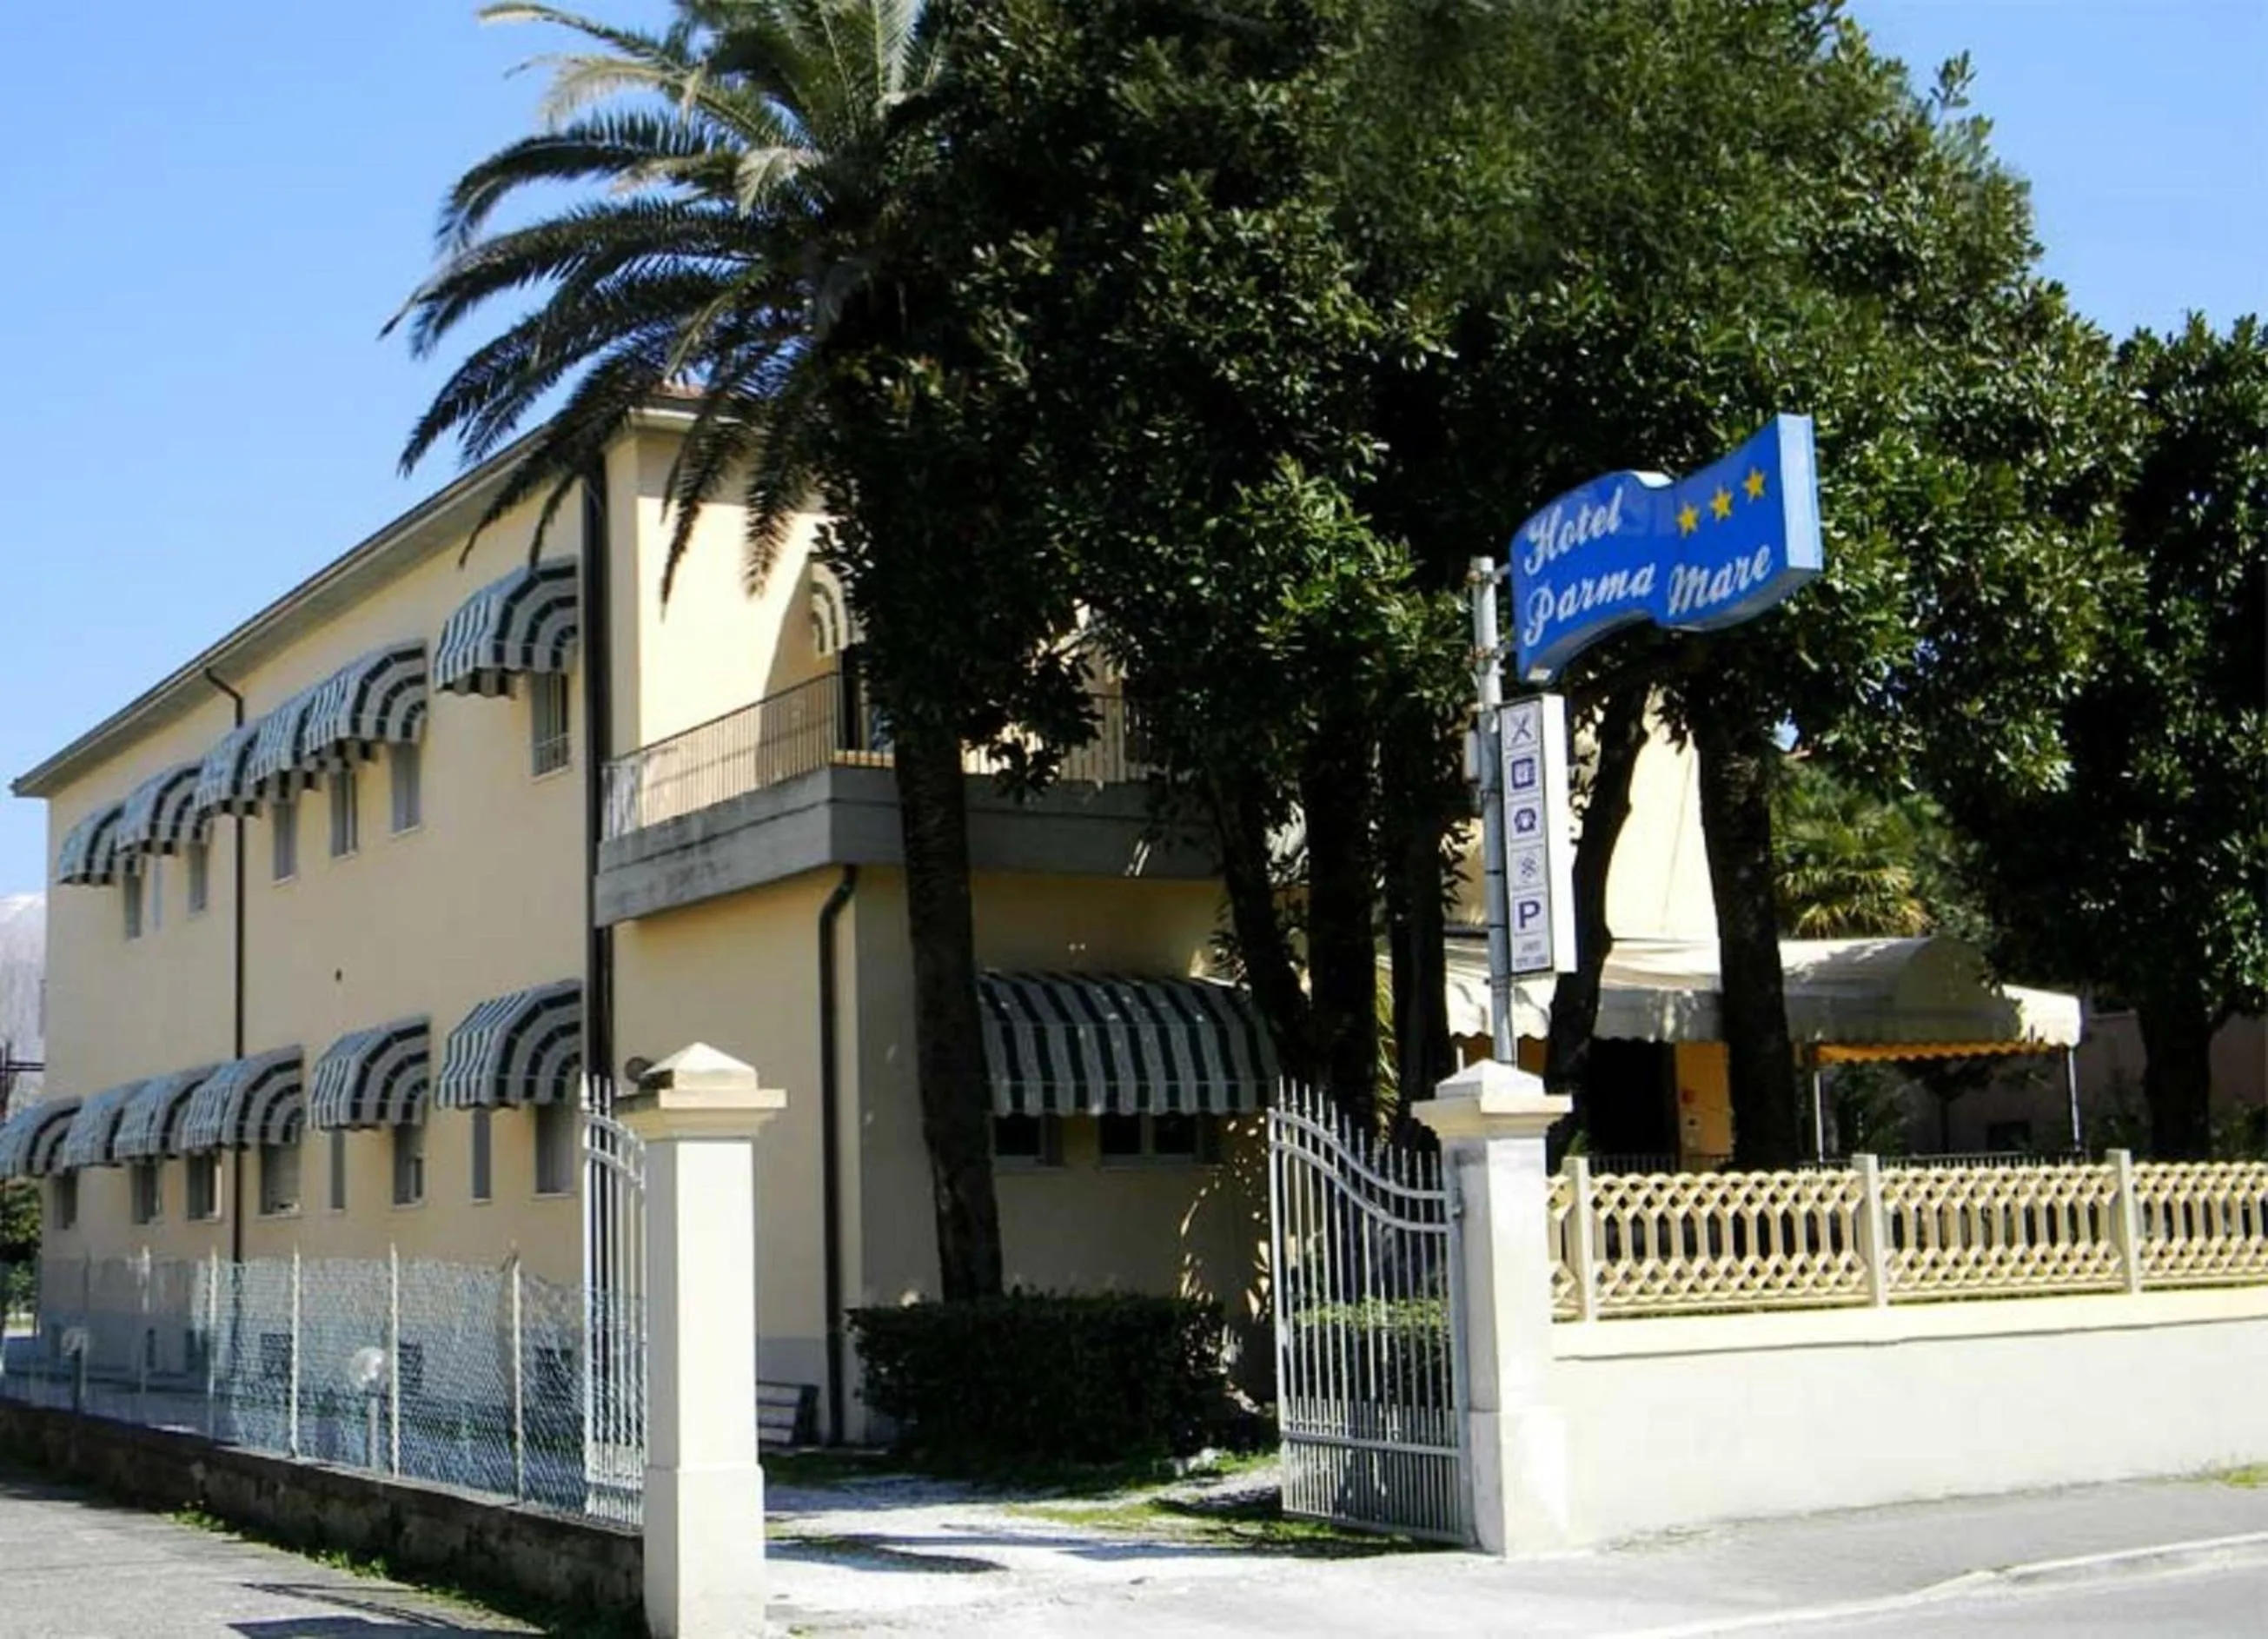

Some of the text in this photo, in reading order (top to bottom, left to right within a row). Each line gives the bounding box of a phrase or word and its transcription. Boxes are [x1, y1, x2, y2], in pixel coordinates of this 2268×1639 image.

[1523, 486, 1621, 575] Hotel
[1523, 545, 1772, 647] Parma Mare
[1519, 900, 1541, 929] P
